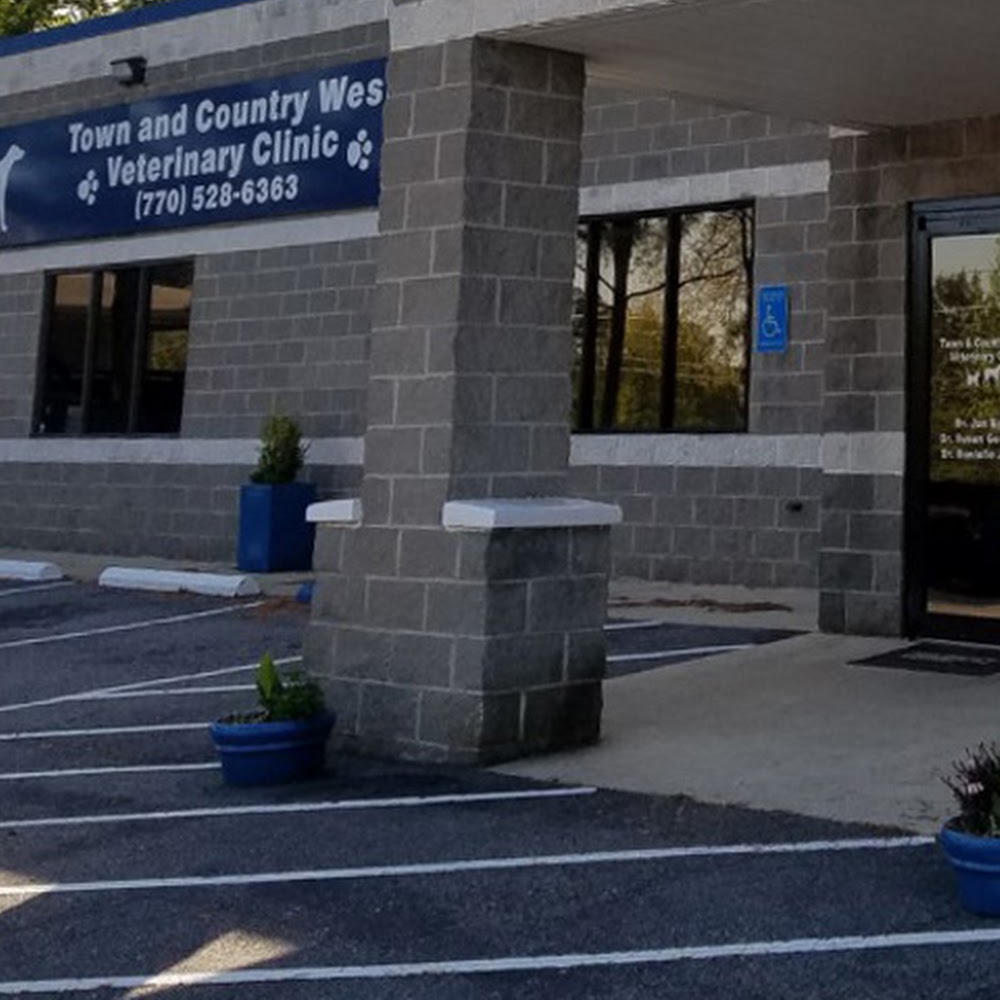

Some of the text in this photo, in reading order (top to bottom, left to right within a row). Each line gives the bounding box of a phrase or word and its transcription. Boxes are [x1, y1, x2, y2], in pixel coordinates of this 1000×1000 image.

[69, 75, 384, 153] Town and Country Wes
[107, 126, 339, 187] Veterinary Clinic
[135, 174, 299, 220] (770) 528-6363
